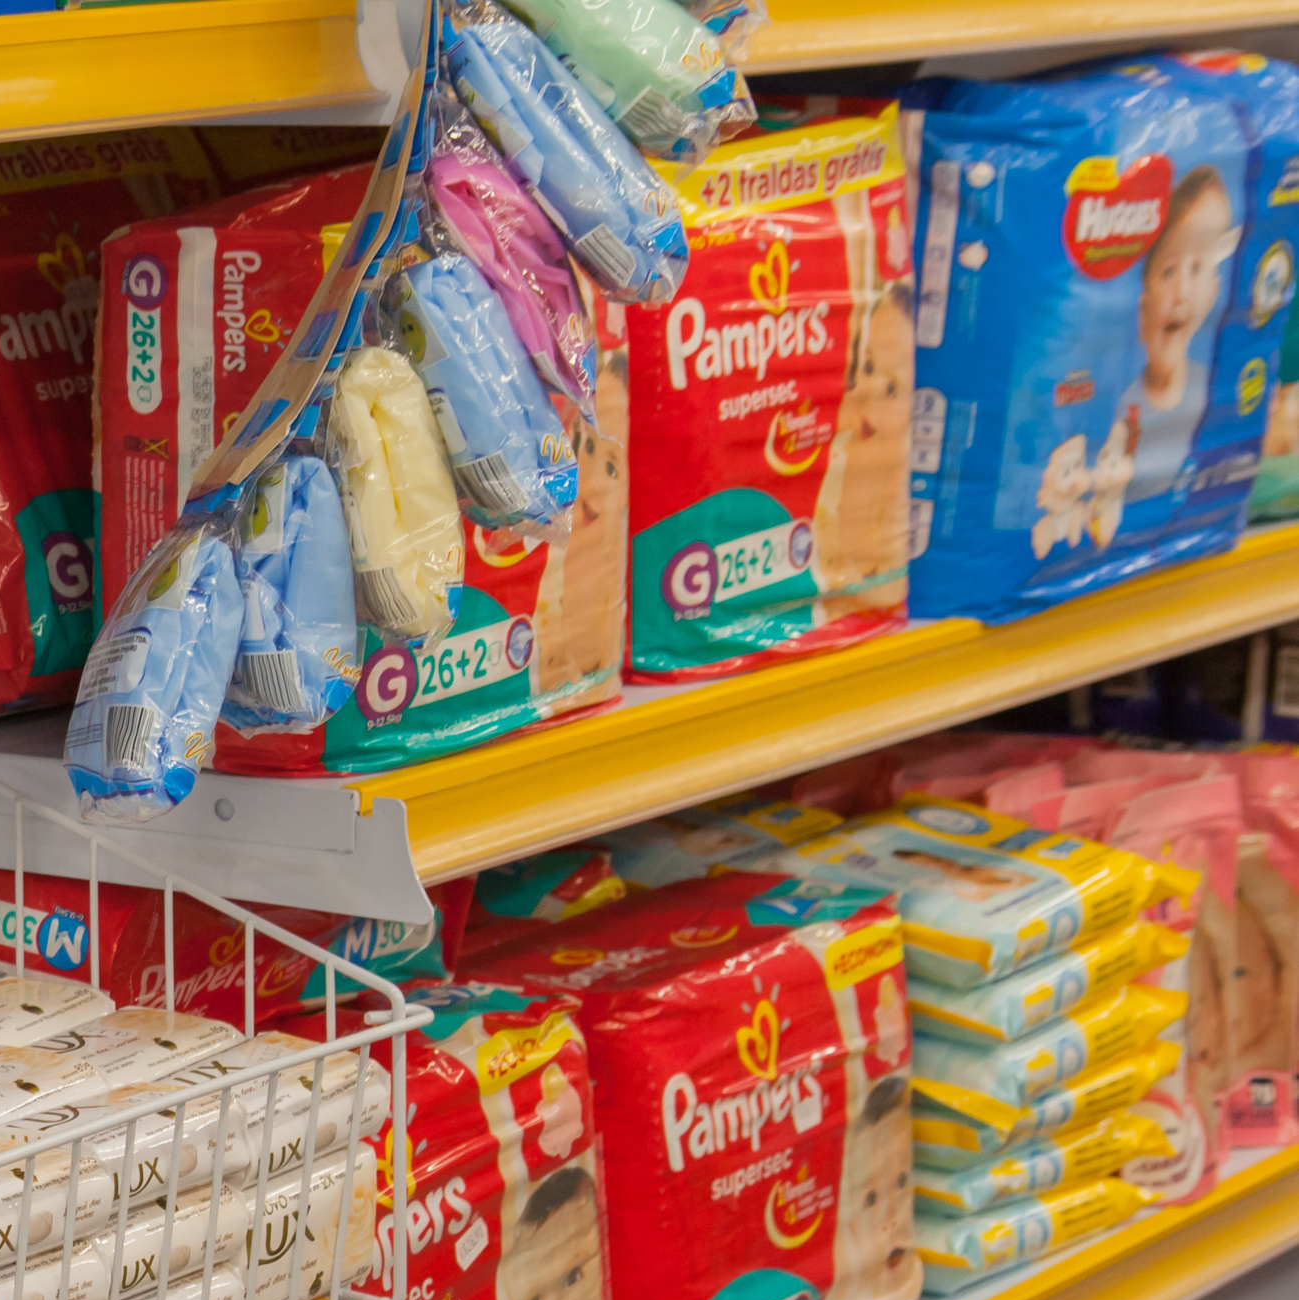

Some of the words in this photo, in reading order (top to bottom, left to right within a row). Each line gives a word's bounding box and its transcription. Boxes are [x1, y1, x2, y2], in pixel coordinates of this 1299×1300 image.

[702, 174, 734, 205] +2
[737, 160, 819, 198] fraldas
[824, 138, 887, 190] grátis
[127, 260, 164, 297] G
[221, 249, 262, 373] Pampers
[130, 310, 156, 382] 26+2
[665, 297, 832, 390] Pampers
[718, 380, 800, 421] supersec
[55, 534, 91, 599] G
[678, 548, 712, 595] G
[721, 537, 773, 589] 26+2
[367, 651, 408, 714] G
[420, 639, 490, 690] 26+2
[45, 918, 87, 966] M
[343, 916, 371, 961] M
[114, 1156, 164, 1199] LUX
[710, 1148, 793, 1201] supersec
[246, 1205, 315, 1270] LUX
[372, 1176, 472, 1292] pers
